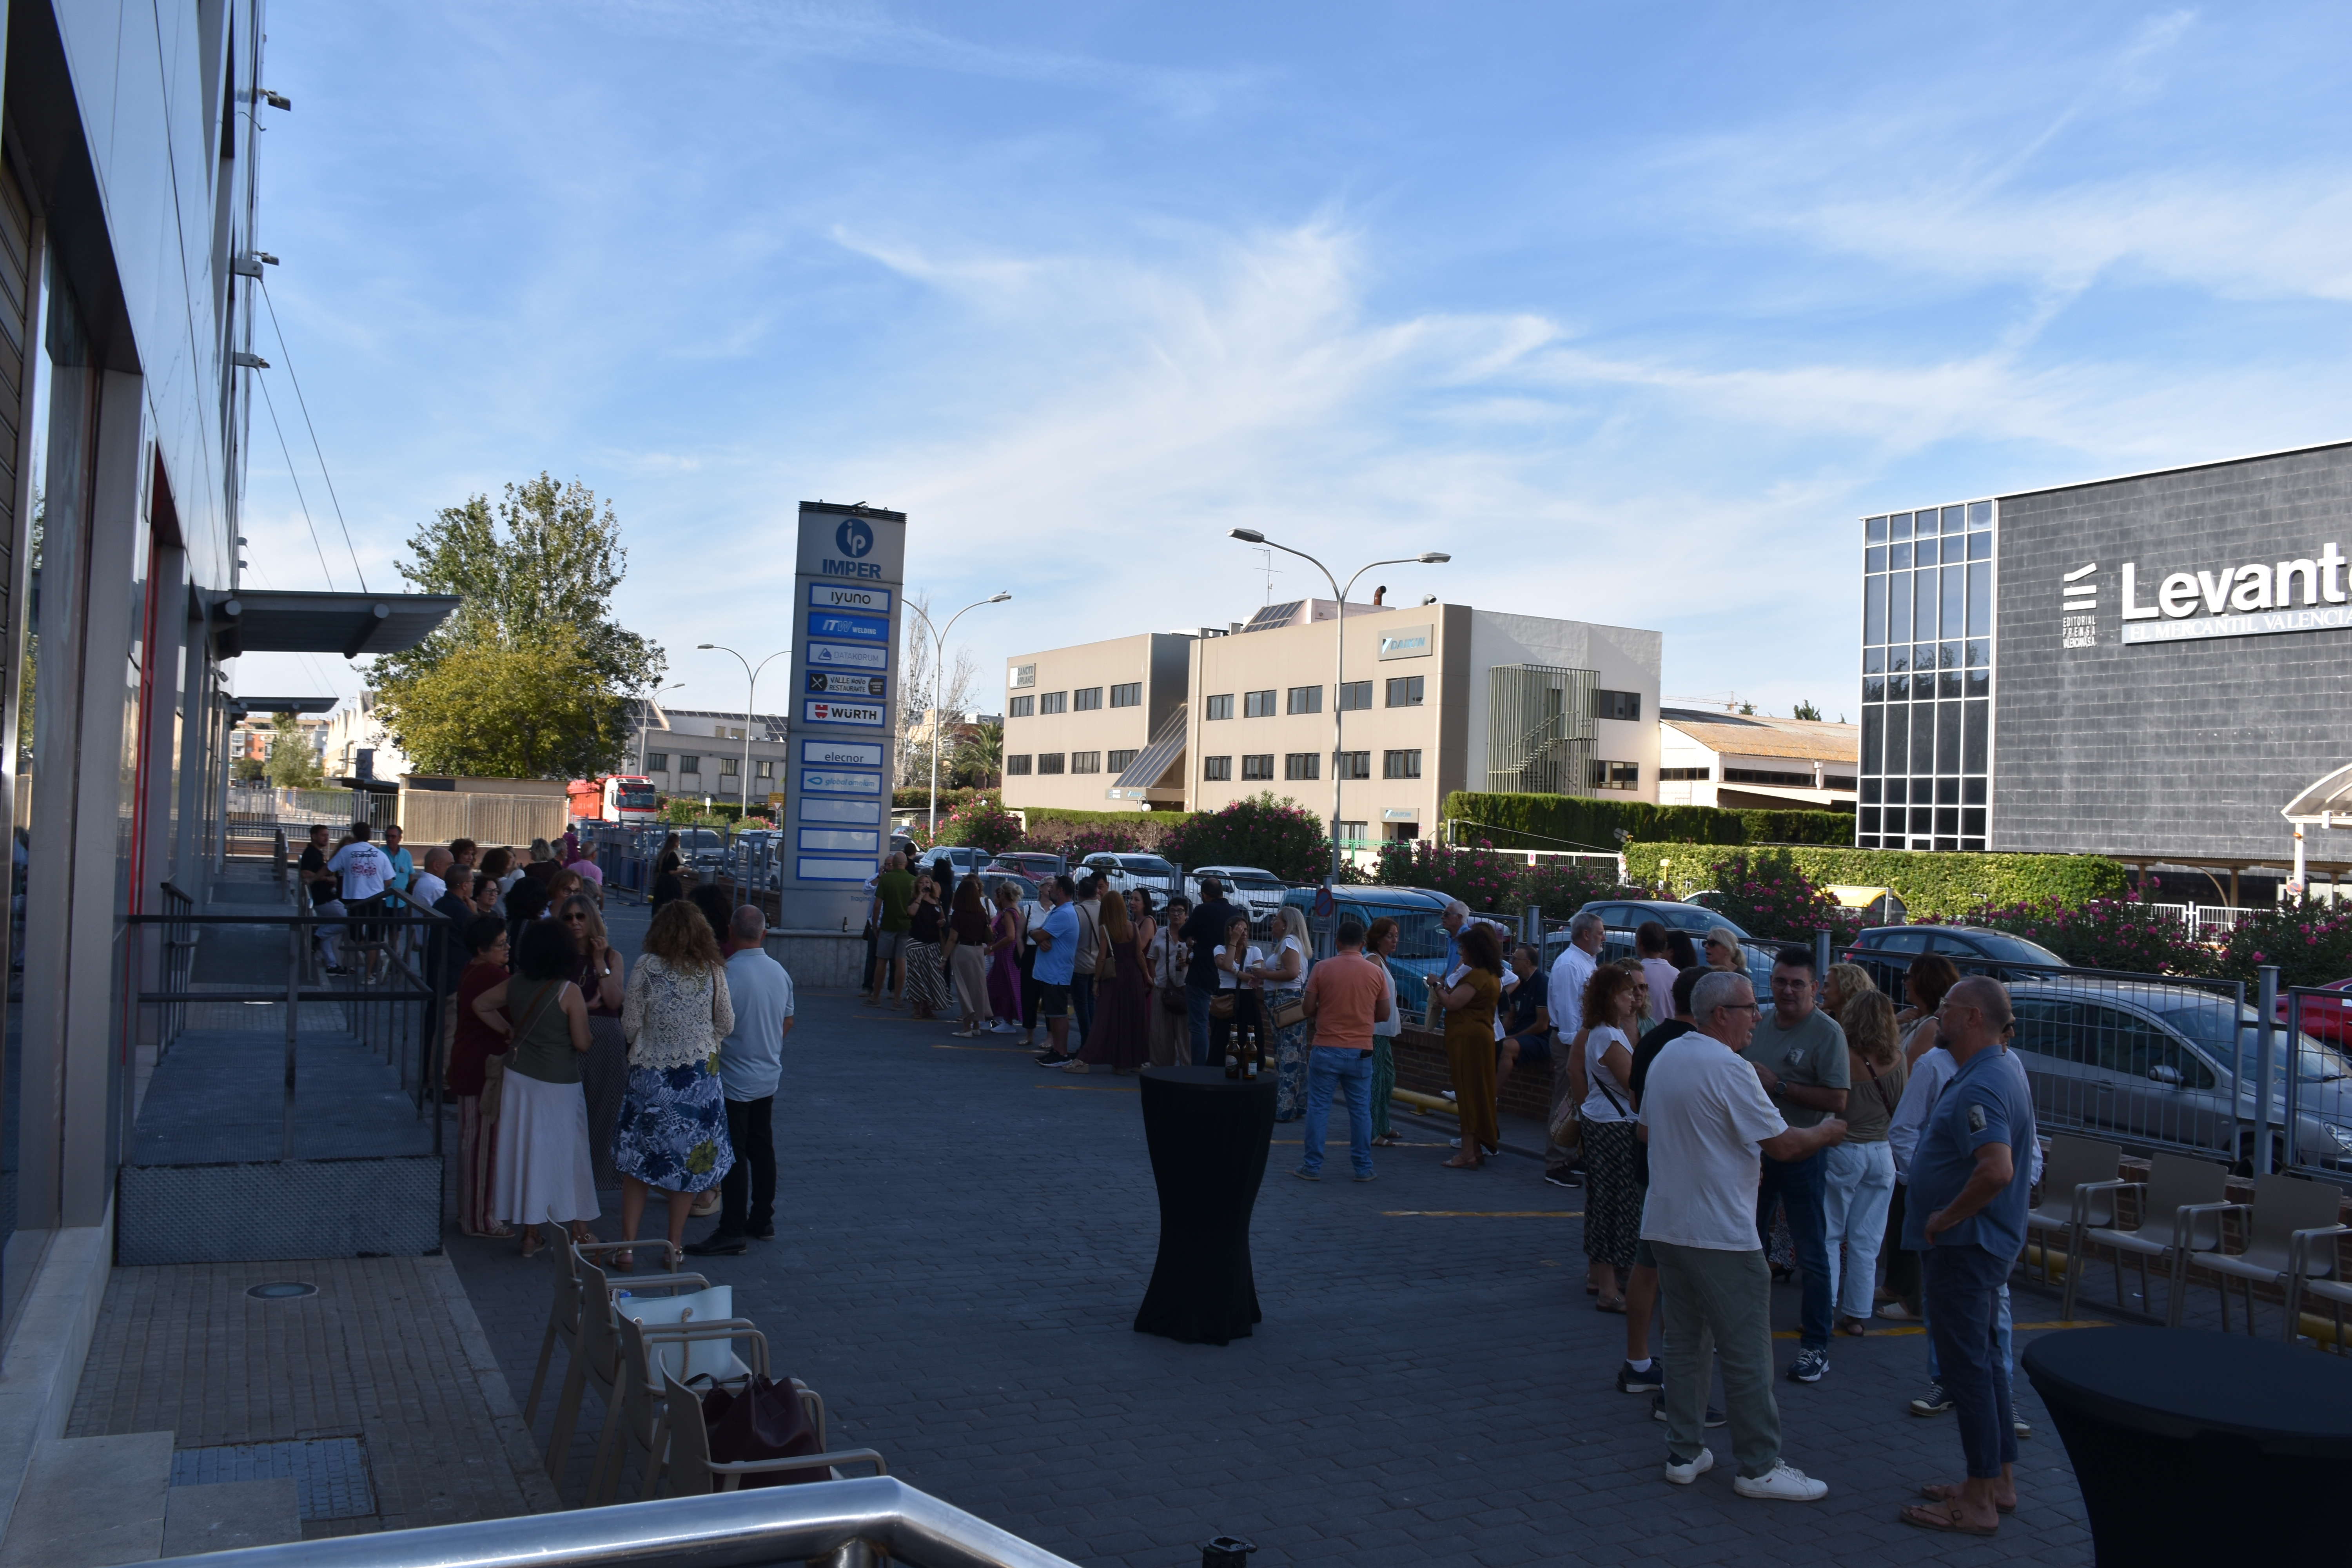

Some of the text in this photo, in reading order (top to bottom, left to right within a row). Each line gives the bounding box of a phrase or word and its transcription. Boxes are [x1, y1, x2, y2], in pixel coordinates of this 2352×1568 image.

[822, 559, 882, 579] IMPER
[2122, 542, 2352, 619] Levant
[831, 591, 871, 605] iyuno
[822, 619, 853, 632] ITW
[2063, 615, 2096, 627] EDITORIAL
[2063, 626, 2096, 637] PRENSA
[2130, 625, 2150, 641] EL
[2155, 616, 2258, 639] MERCANTIL
[1390, 637, 1425, 650] DAIKIN
[834, 652, 878, 662] DATAKORUM
[1018, 666, 1034, 676] ZANOTTI
[831, 708, 877, 720] WÜRTH
[825, 752, 864, 762] elecnor
